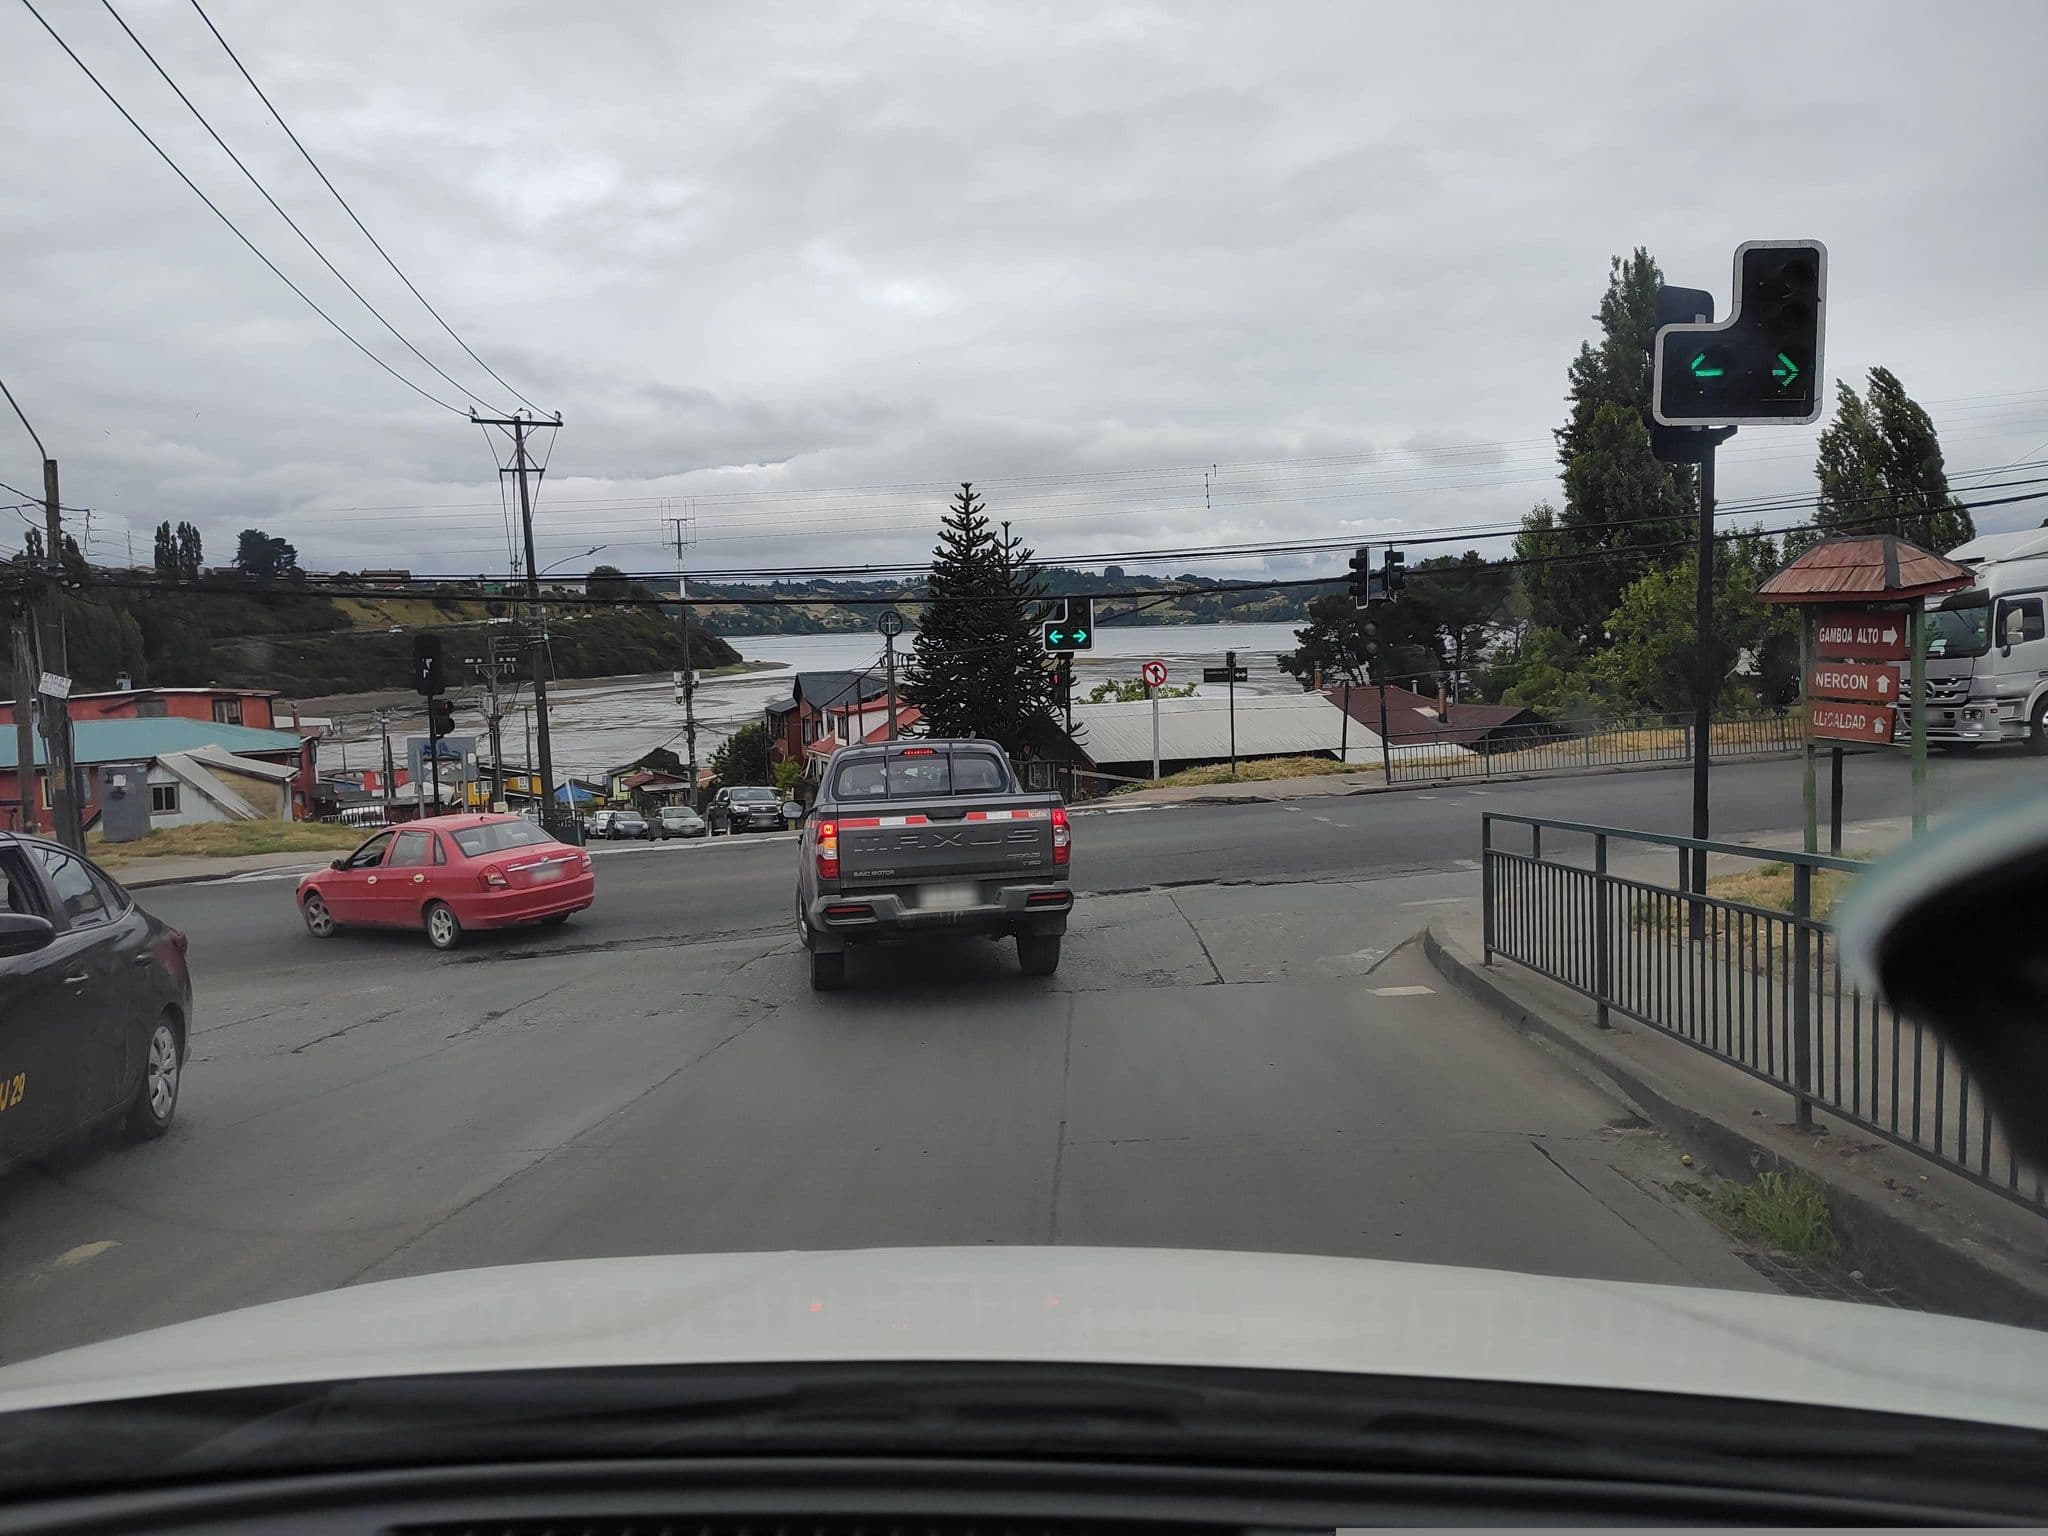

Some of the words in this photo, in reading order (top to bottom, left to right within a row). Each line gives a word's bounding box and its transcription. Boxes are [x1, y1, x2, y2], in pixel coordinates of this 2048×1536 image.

[1819, 627, 1853, 644] GAMBOA
[1856, 627, 1879, 644] ALTO
[1815, 672, 1868, 691] NERCON
